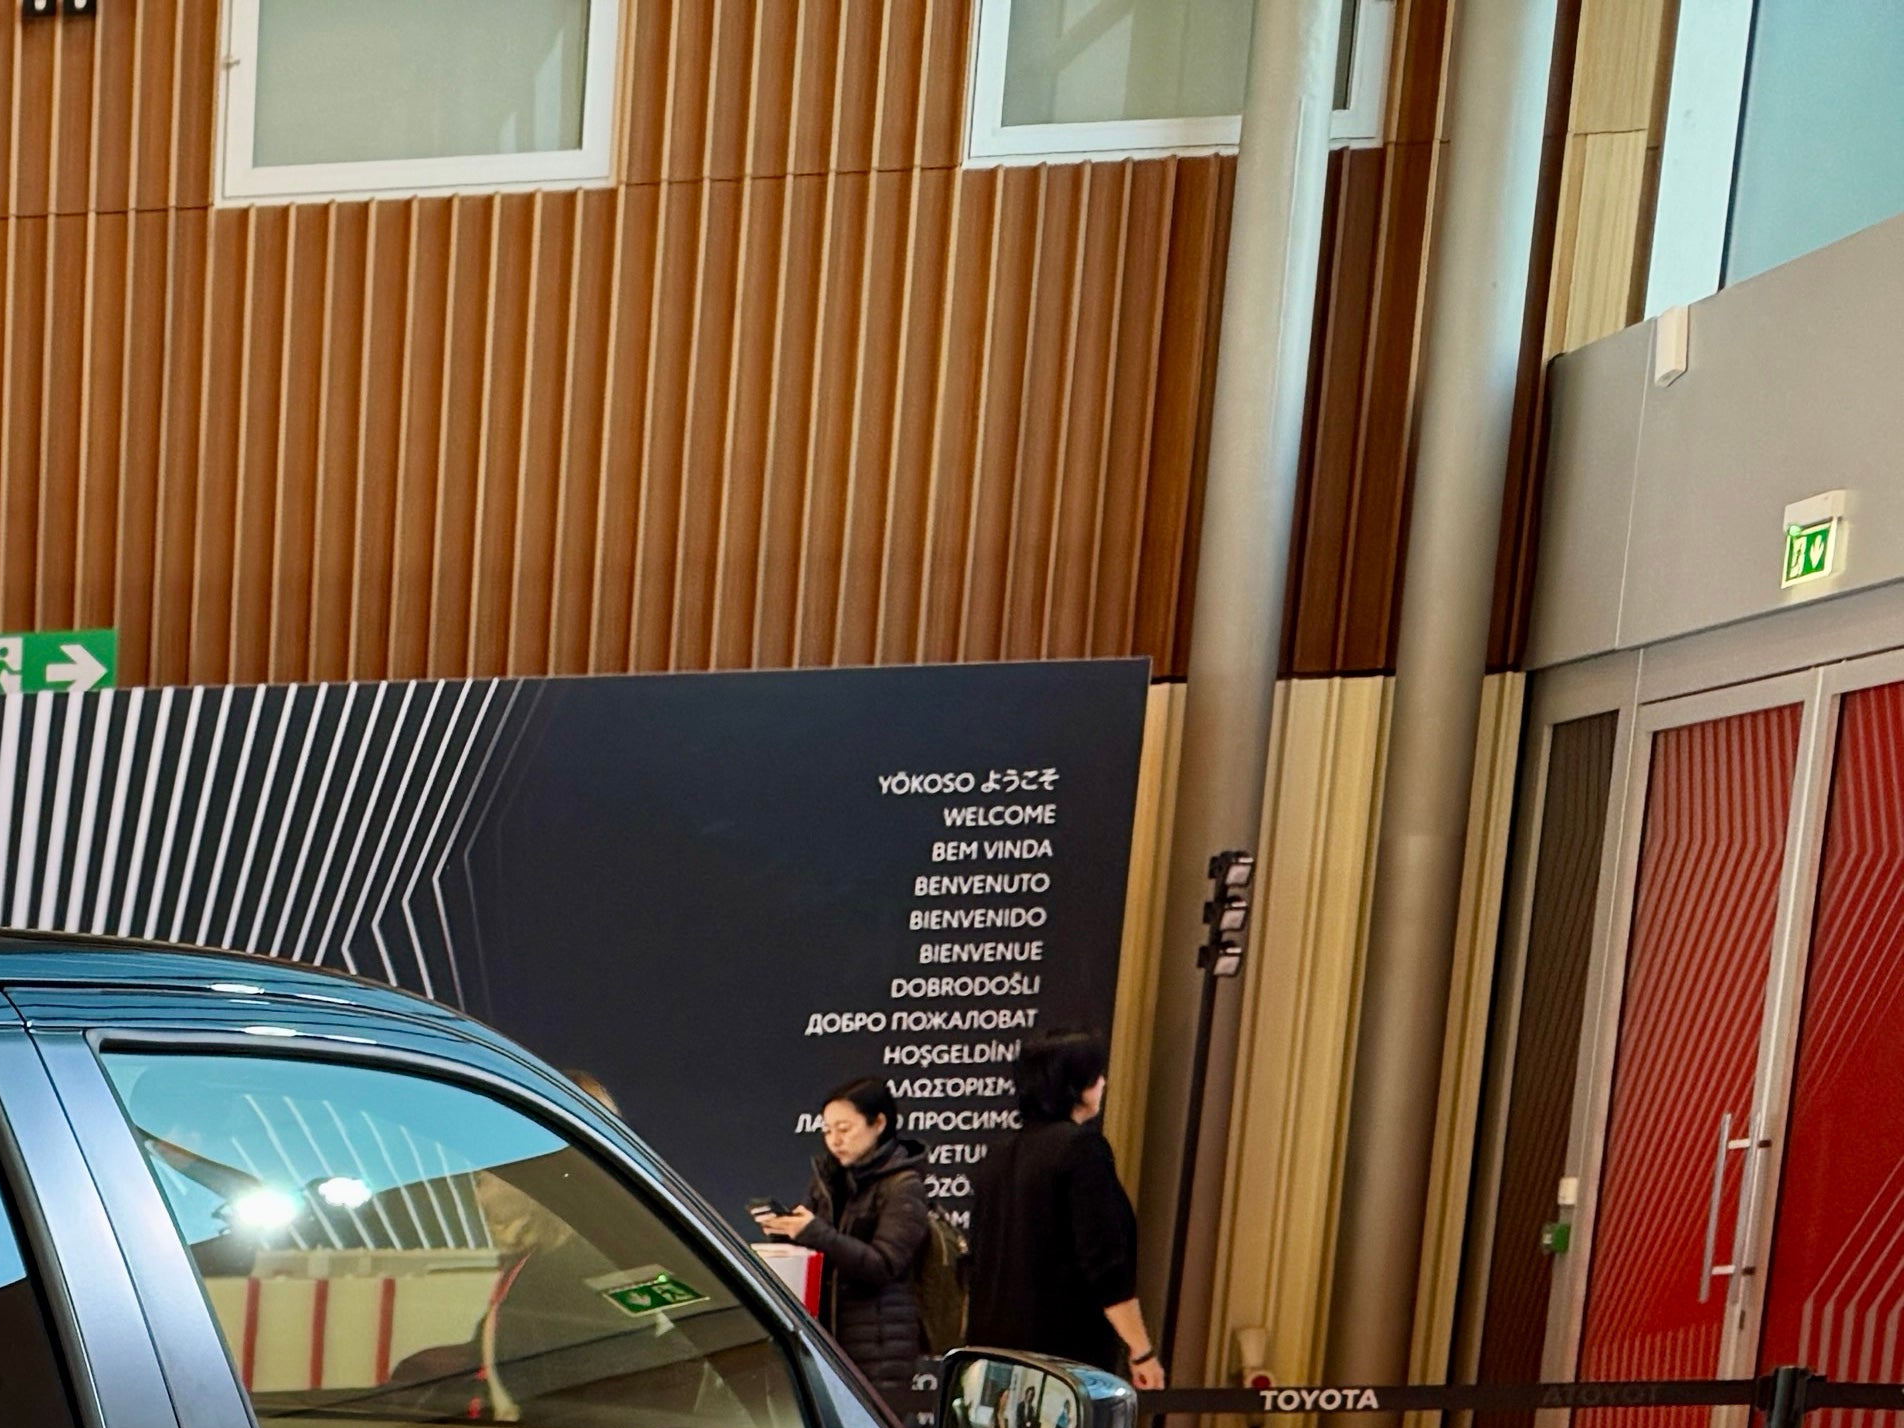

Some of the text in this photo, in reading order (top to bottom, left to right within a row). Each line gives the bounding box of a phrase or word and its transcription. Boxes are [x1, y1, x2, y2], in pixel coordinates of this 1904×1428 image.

[980, 767, 1060, 793] ようこそ
[943, 804, 1057, 827] WELCOME
[931, 839, 1053, 862] BEM VINDA
[914, 873, 1050, 897] BENVENUTO
[909, 907, 1047, 930] BIENVENIDO
[919, 941, 1043, 964] BIENVENUE
[891, 973, 1040, 998] DOBRODOŠLI
[804, 1009, 1038, 1036] ДОБРО ПОЖАЛОВАТ
[883, 1039, 1021, 1068] HOŞGELDİNİ
[1259, 1388, 1379, 1411] TOYOTA
